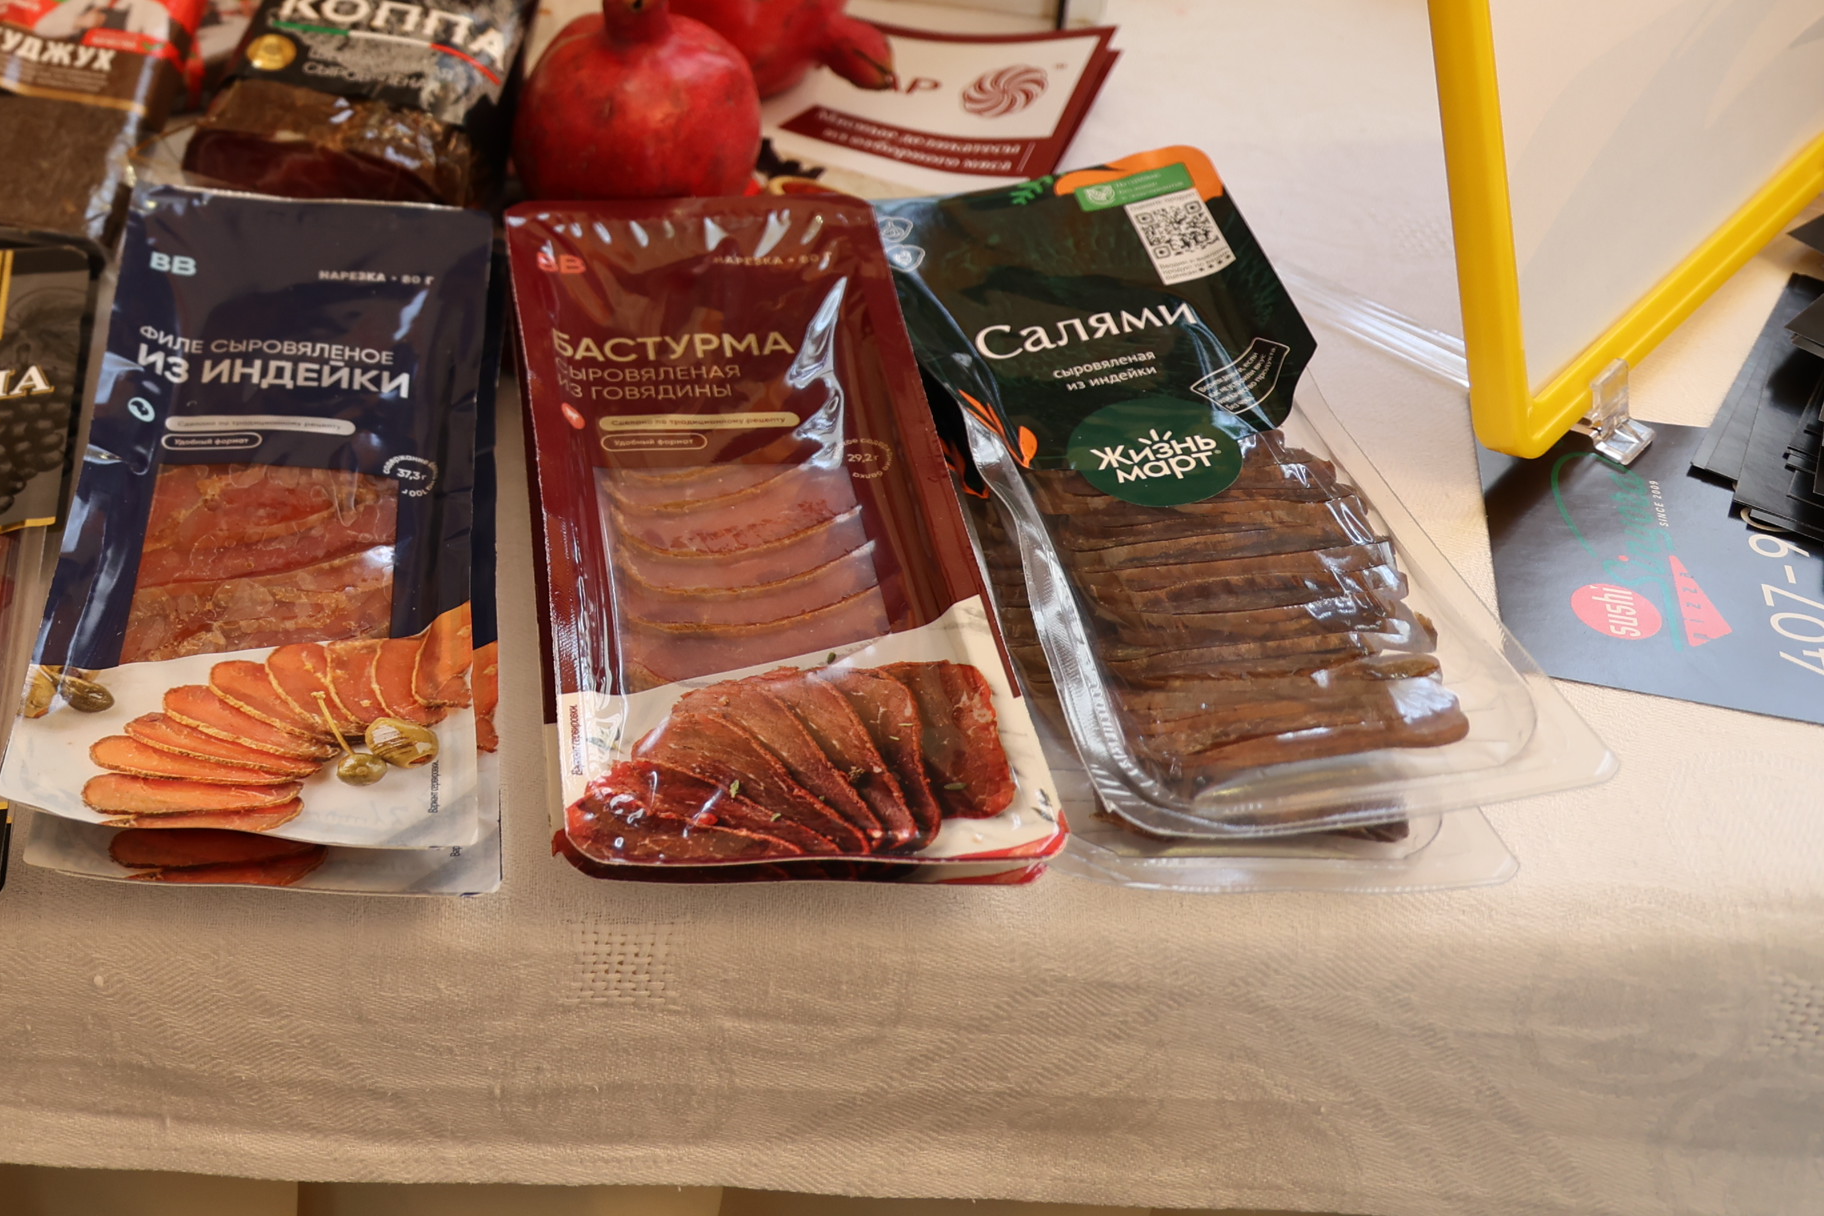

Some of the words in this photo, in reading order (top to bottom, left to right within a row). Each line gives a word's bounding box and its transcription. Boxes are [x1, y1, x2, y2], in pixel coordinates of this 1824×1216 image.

[318, 269, 387, 284] НАРЕЗКА
[138, 324, 205, 356] ФИЛЕ
[210, 337, 396, 366] СЫРОВЯЛЕНОЕ
[551, 328, 795, 364] БАСТУРМА
[976, 301, 1198, 362] Салями
[137, 342, 190, 384] ИЗ
[201, 357, 411, 400] ИНДЕЙКИ
[555, 358, 742, 384] СЫРОВЯЛЕНАЯ
[1052, 349, 1157, 381] сыровяленая
[1065, 378, 1087, 392] из
[1088, 364, 1158, 389] индейки
[591, 384, 733, 401] ГОВЯДИНЫ
[846, 453, 874, 464] 29,2
[397, 467, 421, 480] 37,3
[1649, 479, 1665, 501] 2009
[1659, 497, 1671, 528] SINCE
[1593, 583, 1640, 638] sushi
